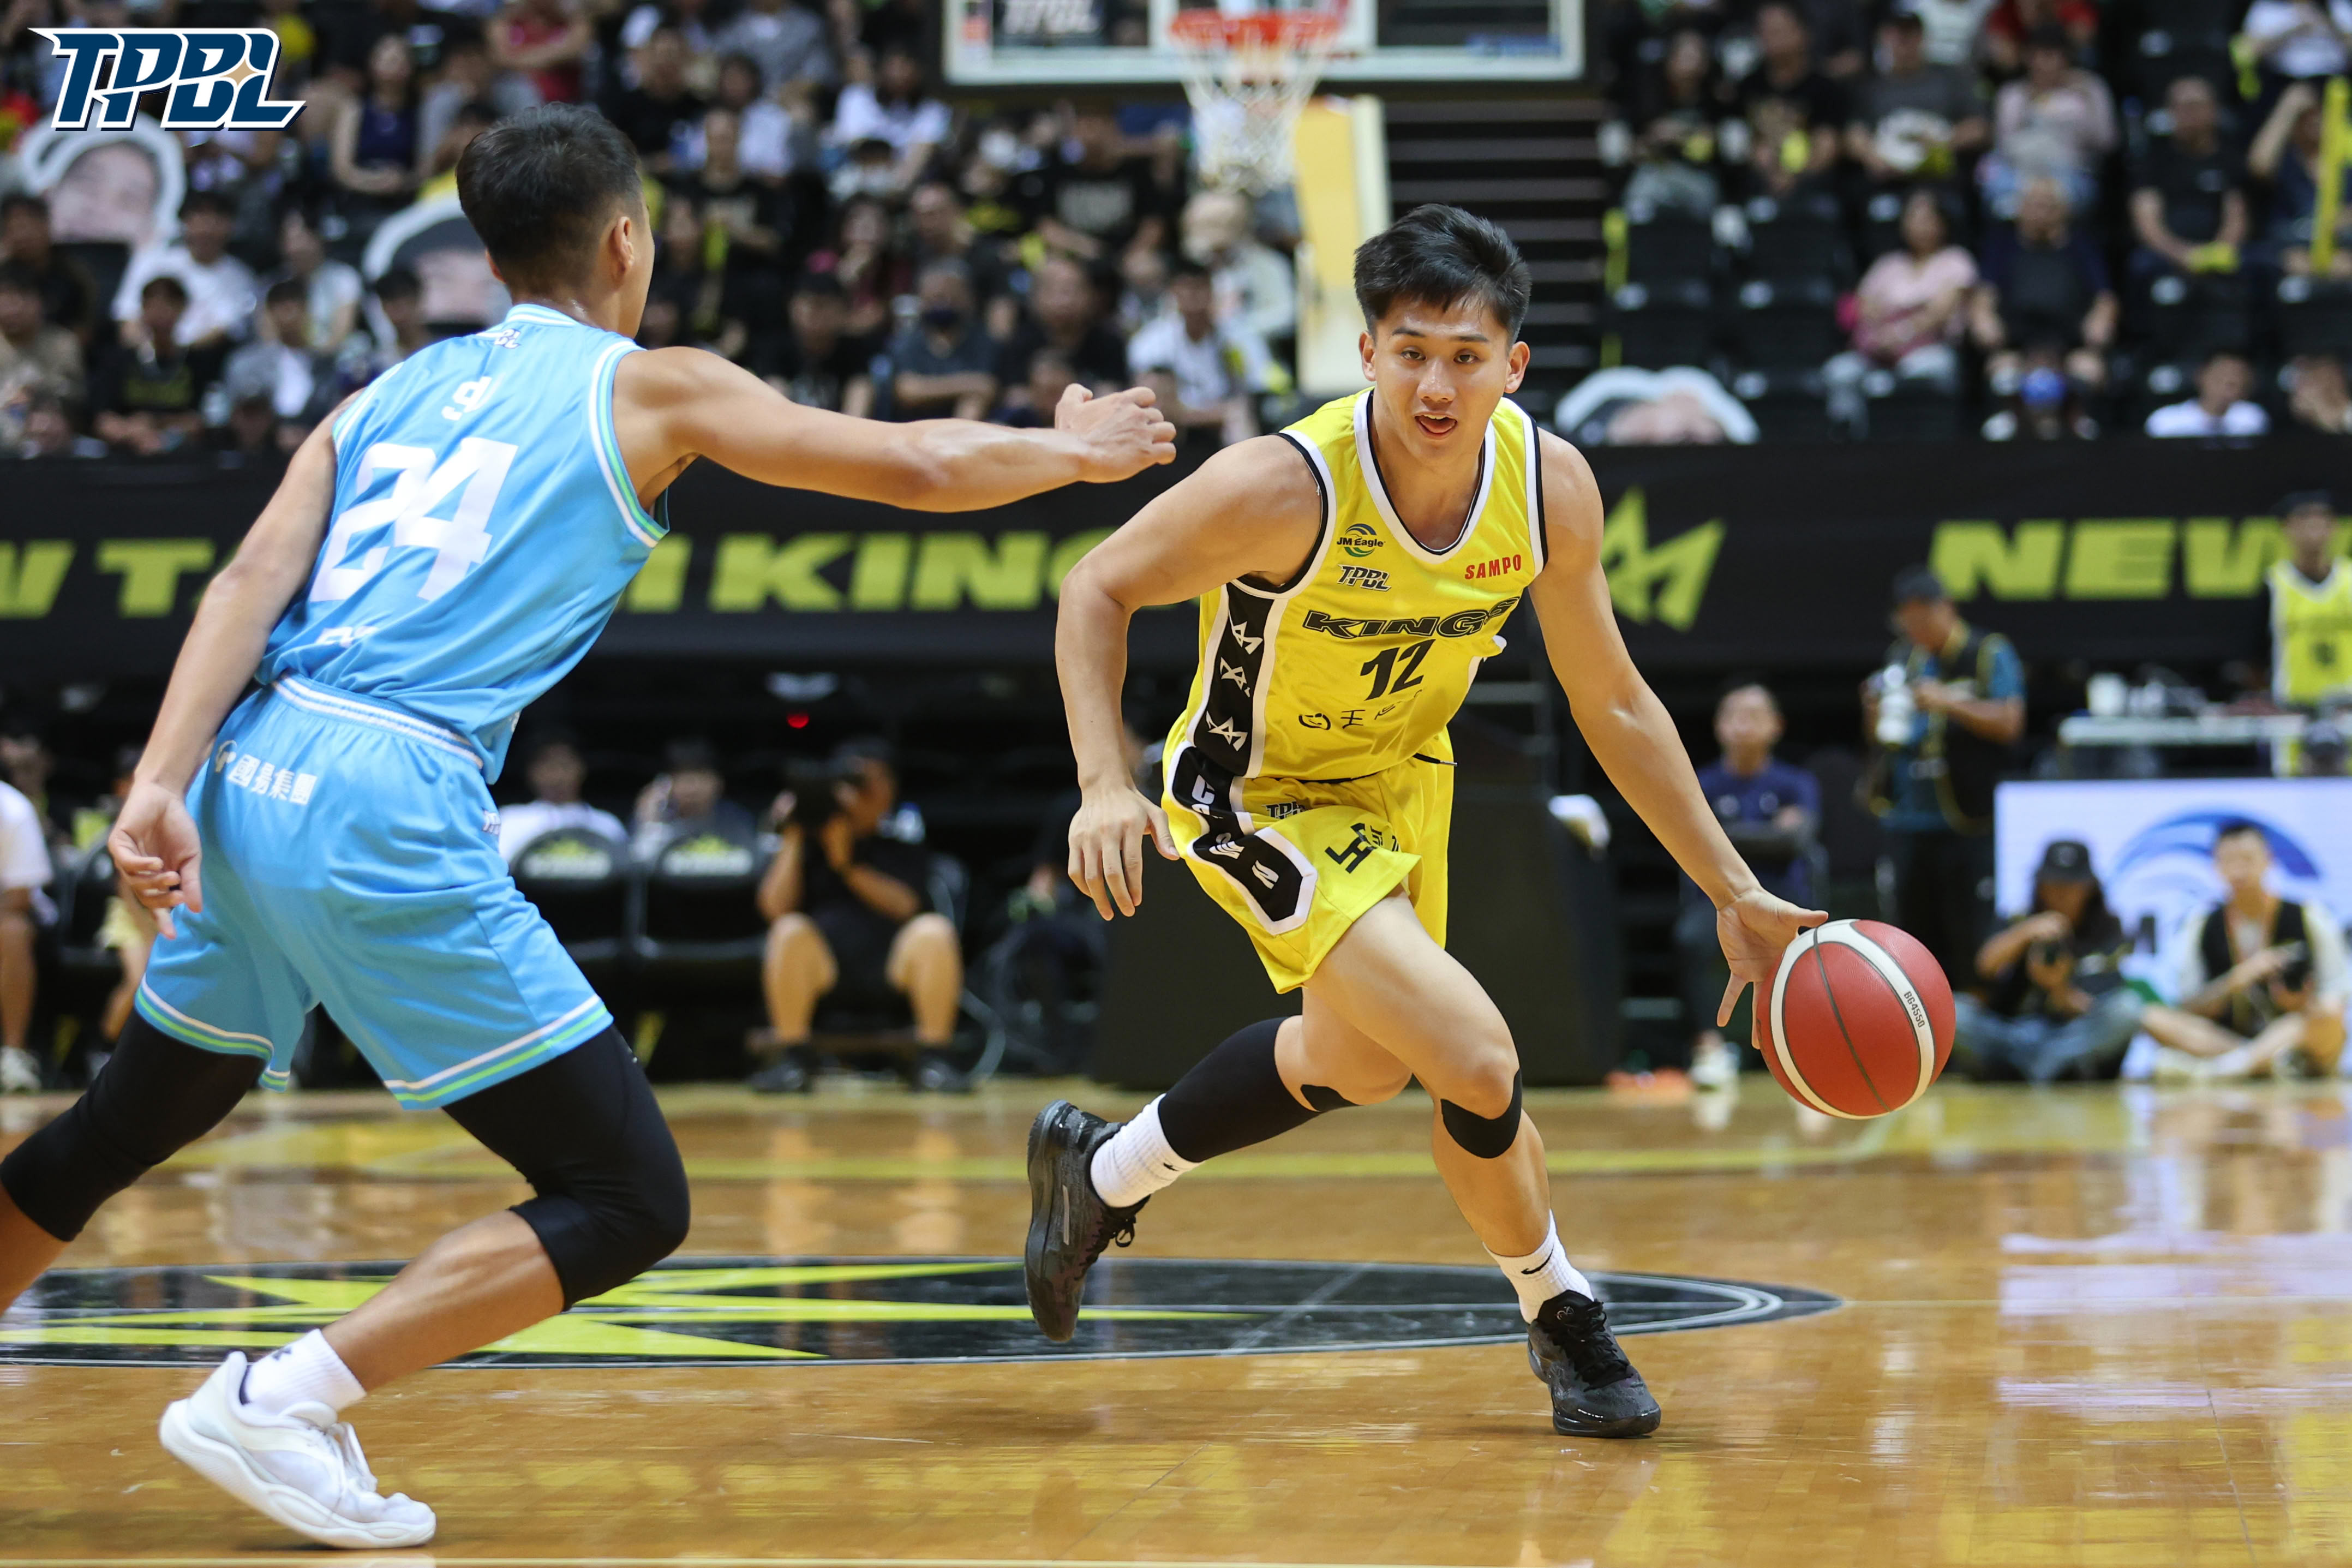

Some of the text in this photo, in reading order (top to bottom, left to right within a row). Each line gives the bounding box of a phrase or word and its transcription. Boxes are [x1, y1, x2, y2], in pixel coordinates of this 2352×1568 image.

[308, 436, 518, 602] 24
[1337, 537, 1384, 547] JM Eagle
[1337, 564, 1392, 591] TPBL
[1464, 554, 1522, 579] SAMPO
[1360, 639, 1436, 701] 12
[1904, 991, 1925, 1028] BG4550
